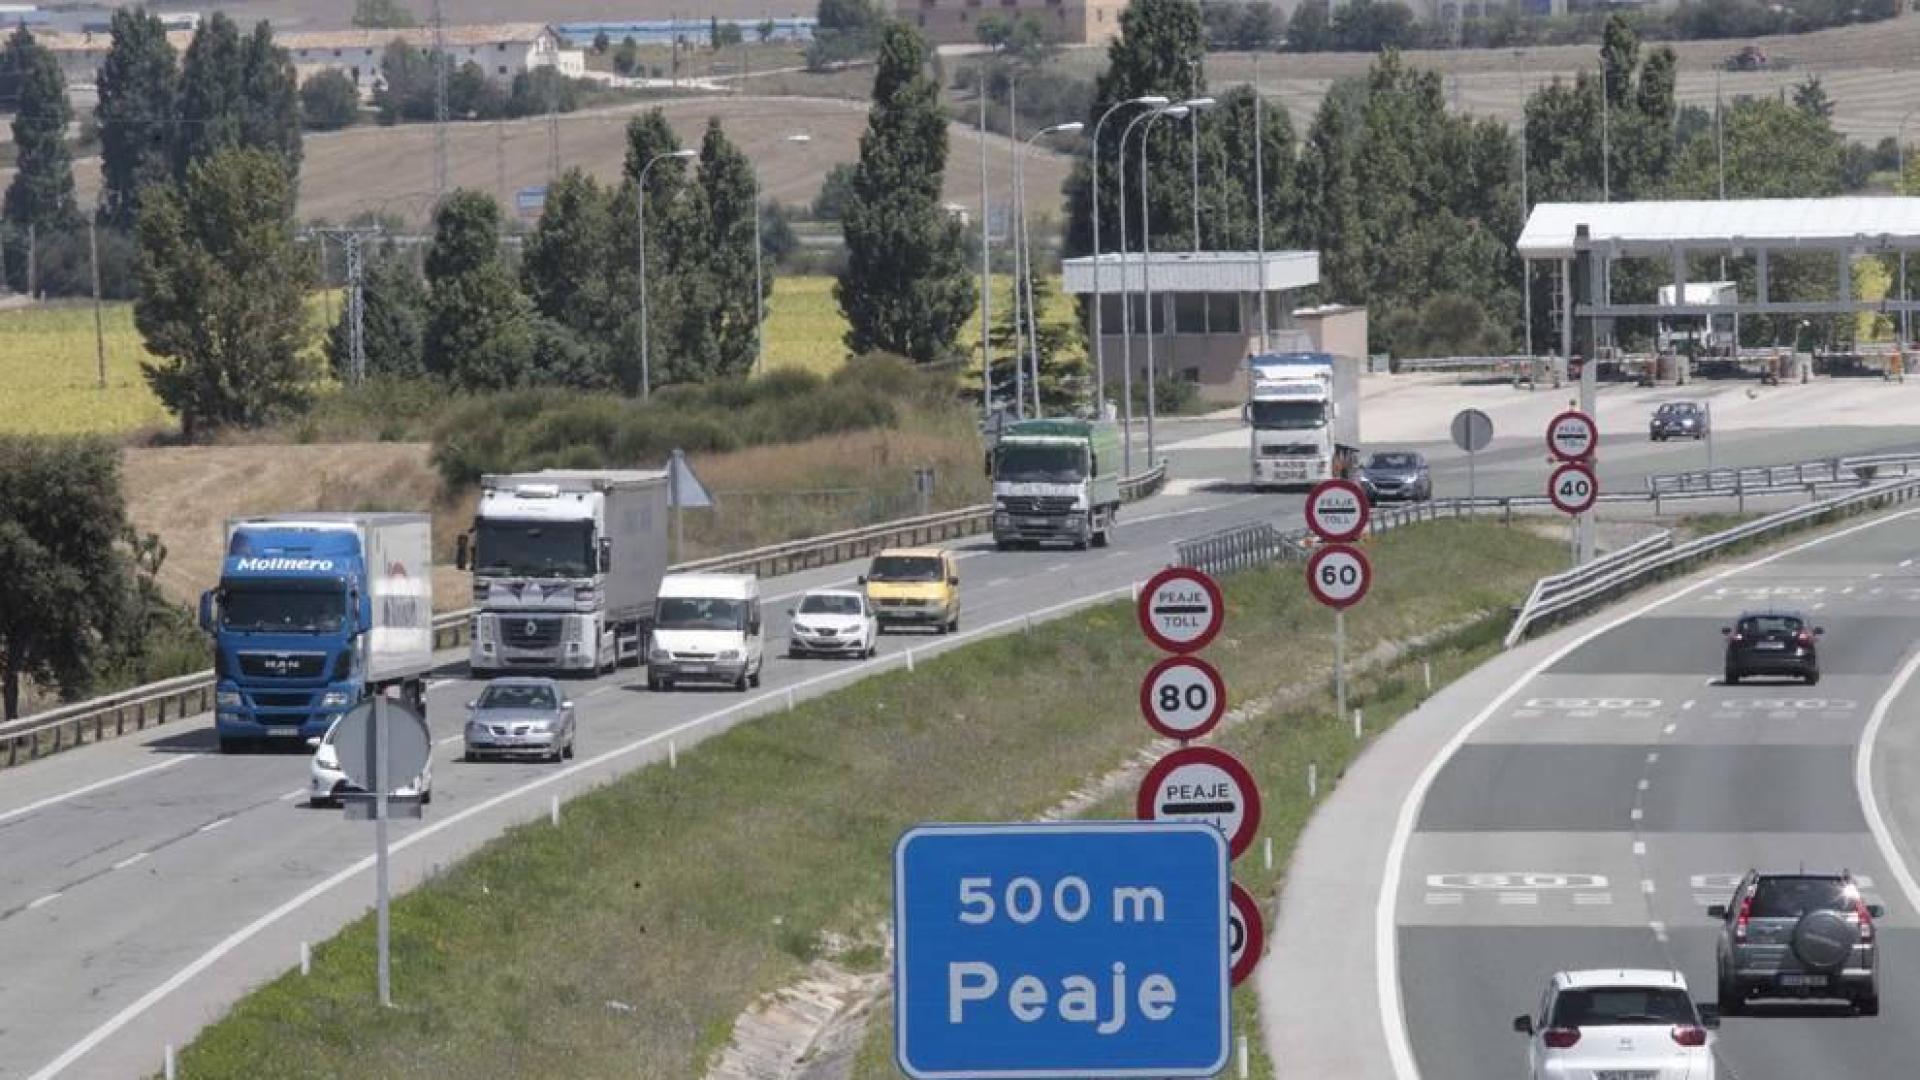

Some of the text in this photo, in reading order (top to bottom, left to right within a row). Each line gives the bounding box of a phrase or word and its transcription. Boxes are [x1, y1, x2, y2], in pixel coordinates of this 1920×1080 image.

[1560, 480, 1589, 497] 40
[1319, 497, 1355, 507] PEAJE
[1323, 514, 1351, 525] TOLL
[238, 557, 333, 571] Molinero
[1321, 565, 1357, 586] 60
[1158, 592, 1203, 603] PEAJE
[1162, 616, 1200, 628] TOLL
[1159, 683, 1208, 712] 80
[1166, 782, 1230, 800] PEAJE
[958, 875, 1165, 925] 500 m
[948, 961, 1178, 1035] Peaje
